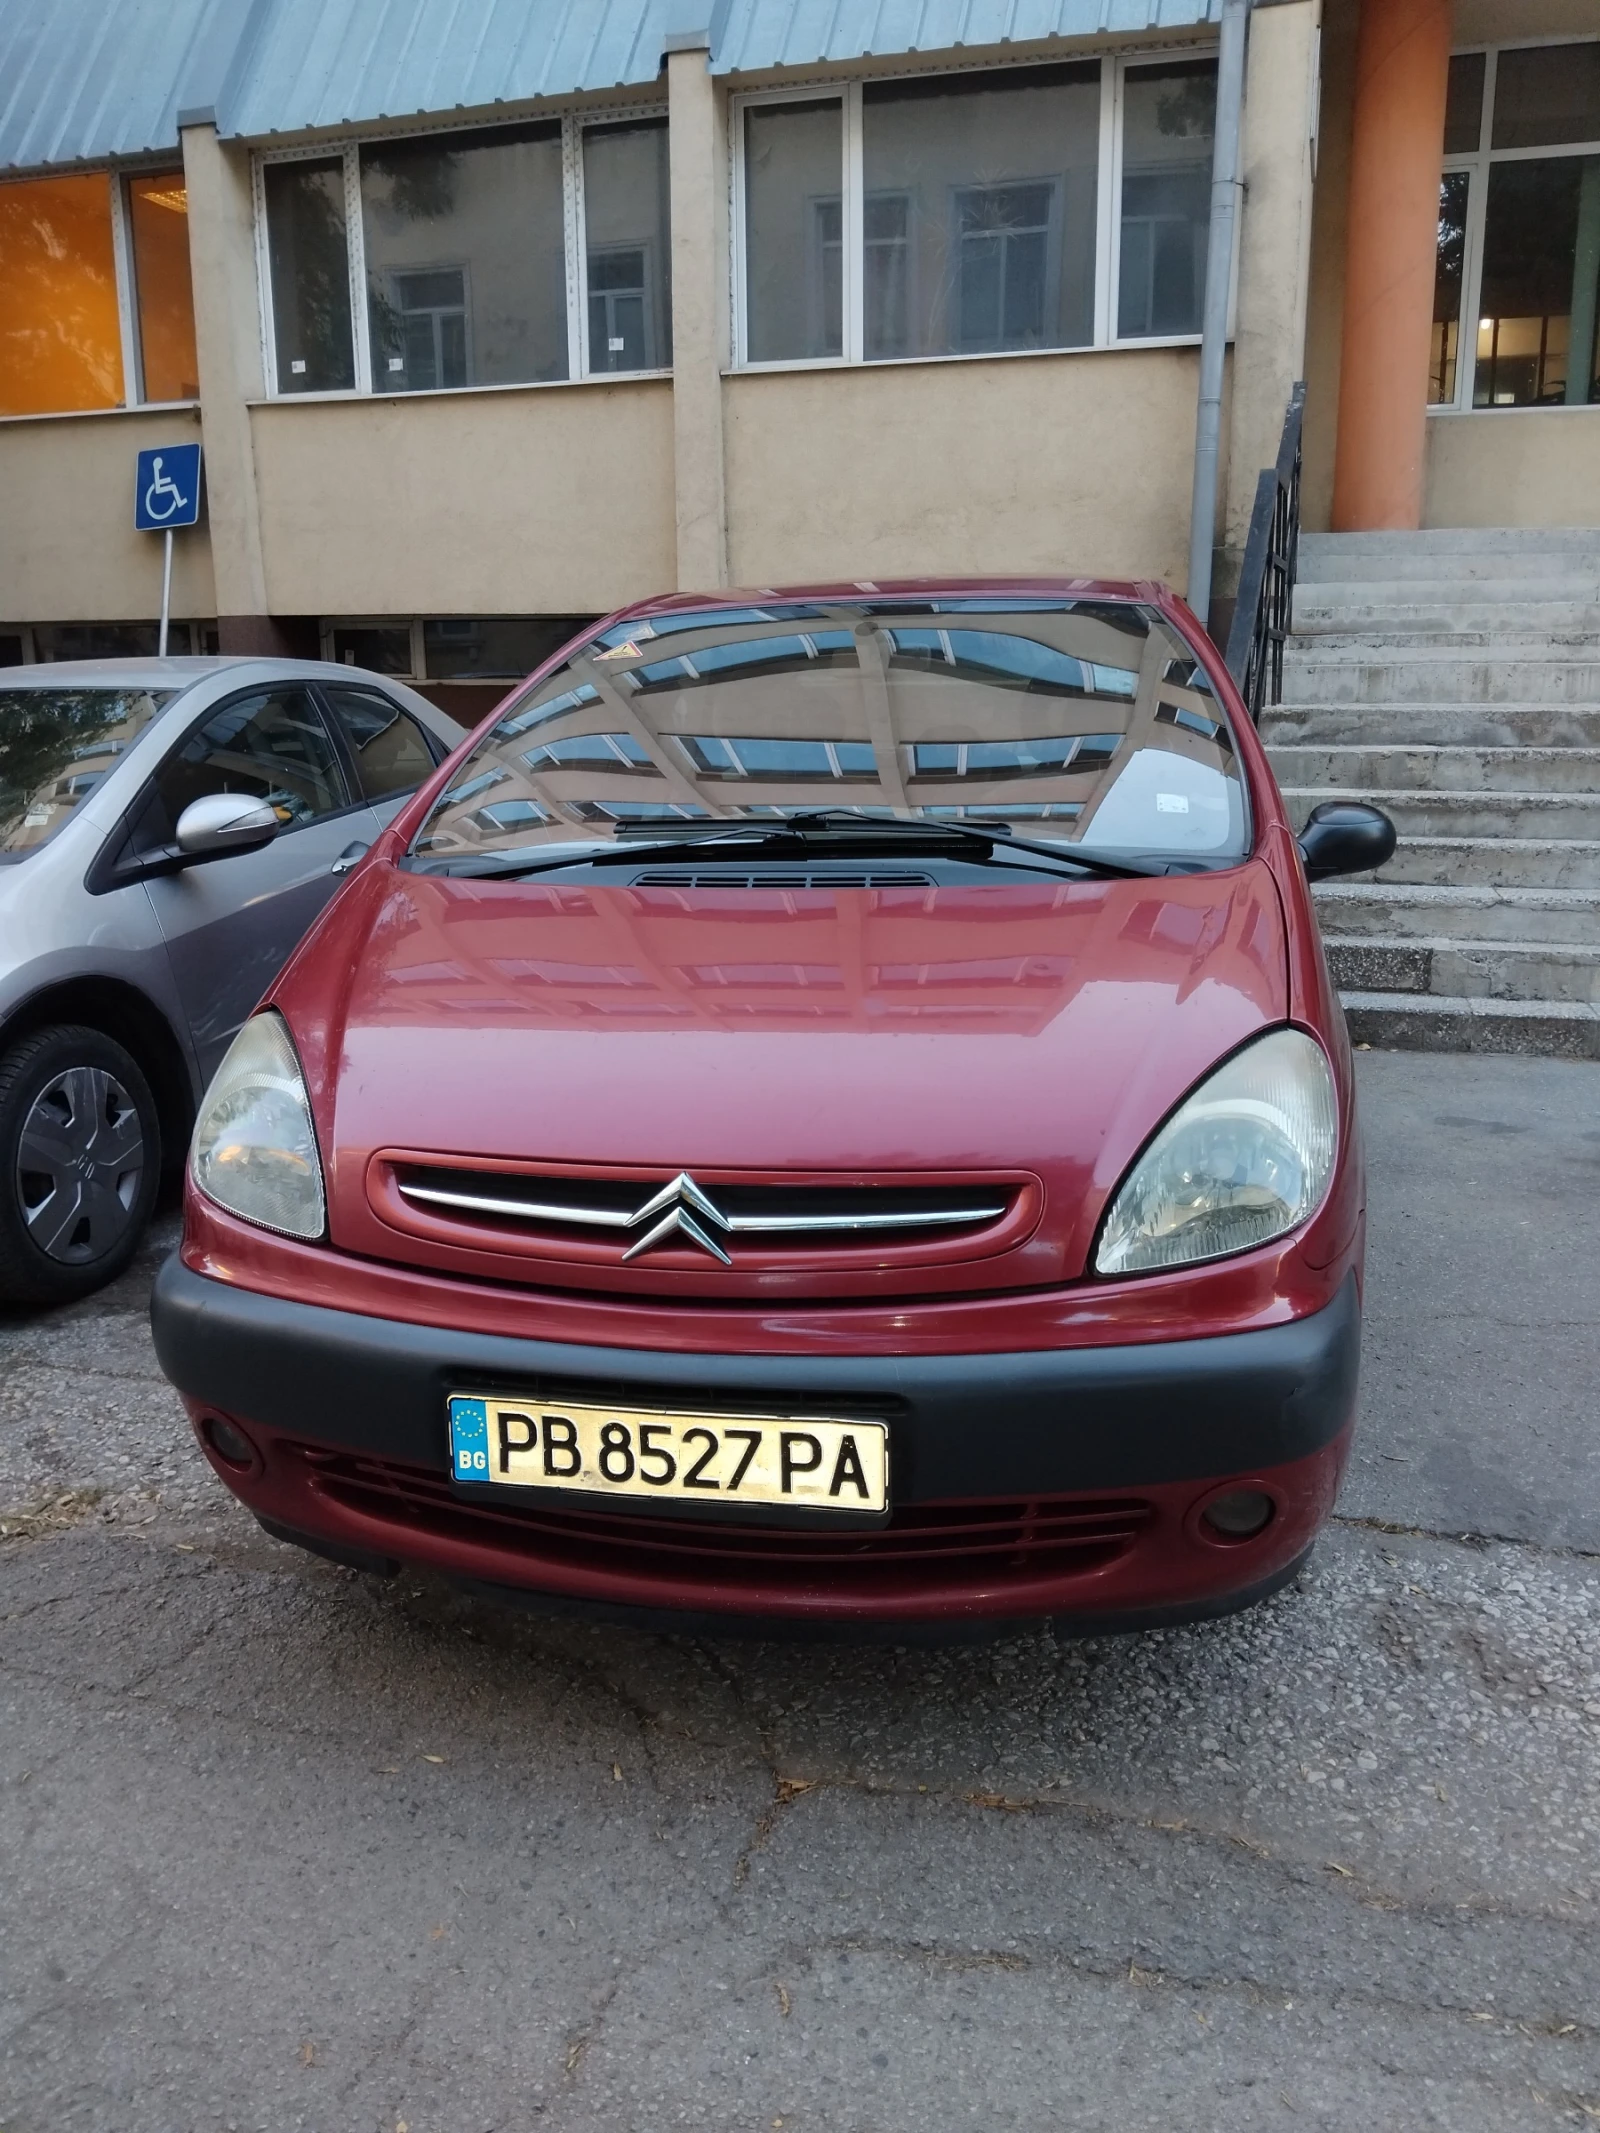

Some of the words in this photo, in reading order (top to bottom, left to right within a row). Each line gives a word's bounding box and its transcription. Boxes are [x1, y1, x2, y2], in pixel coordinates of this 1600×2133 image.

[459, 1450, 486, 1470] BG
[497, 1412, 582, 1478] PB
[600, 1422, 763, 1491] 8527
[780, 1432, 870, 1499] PA
